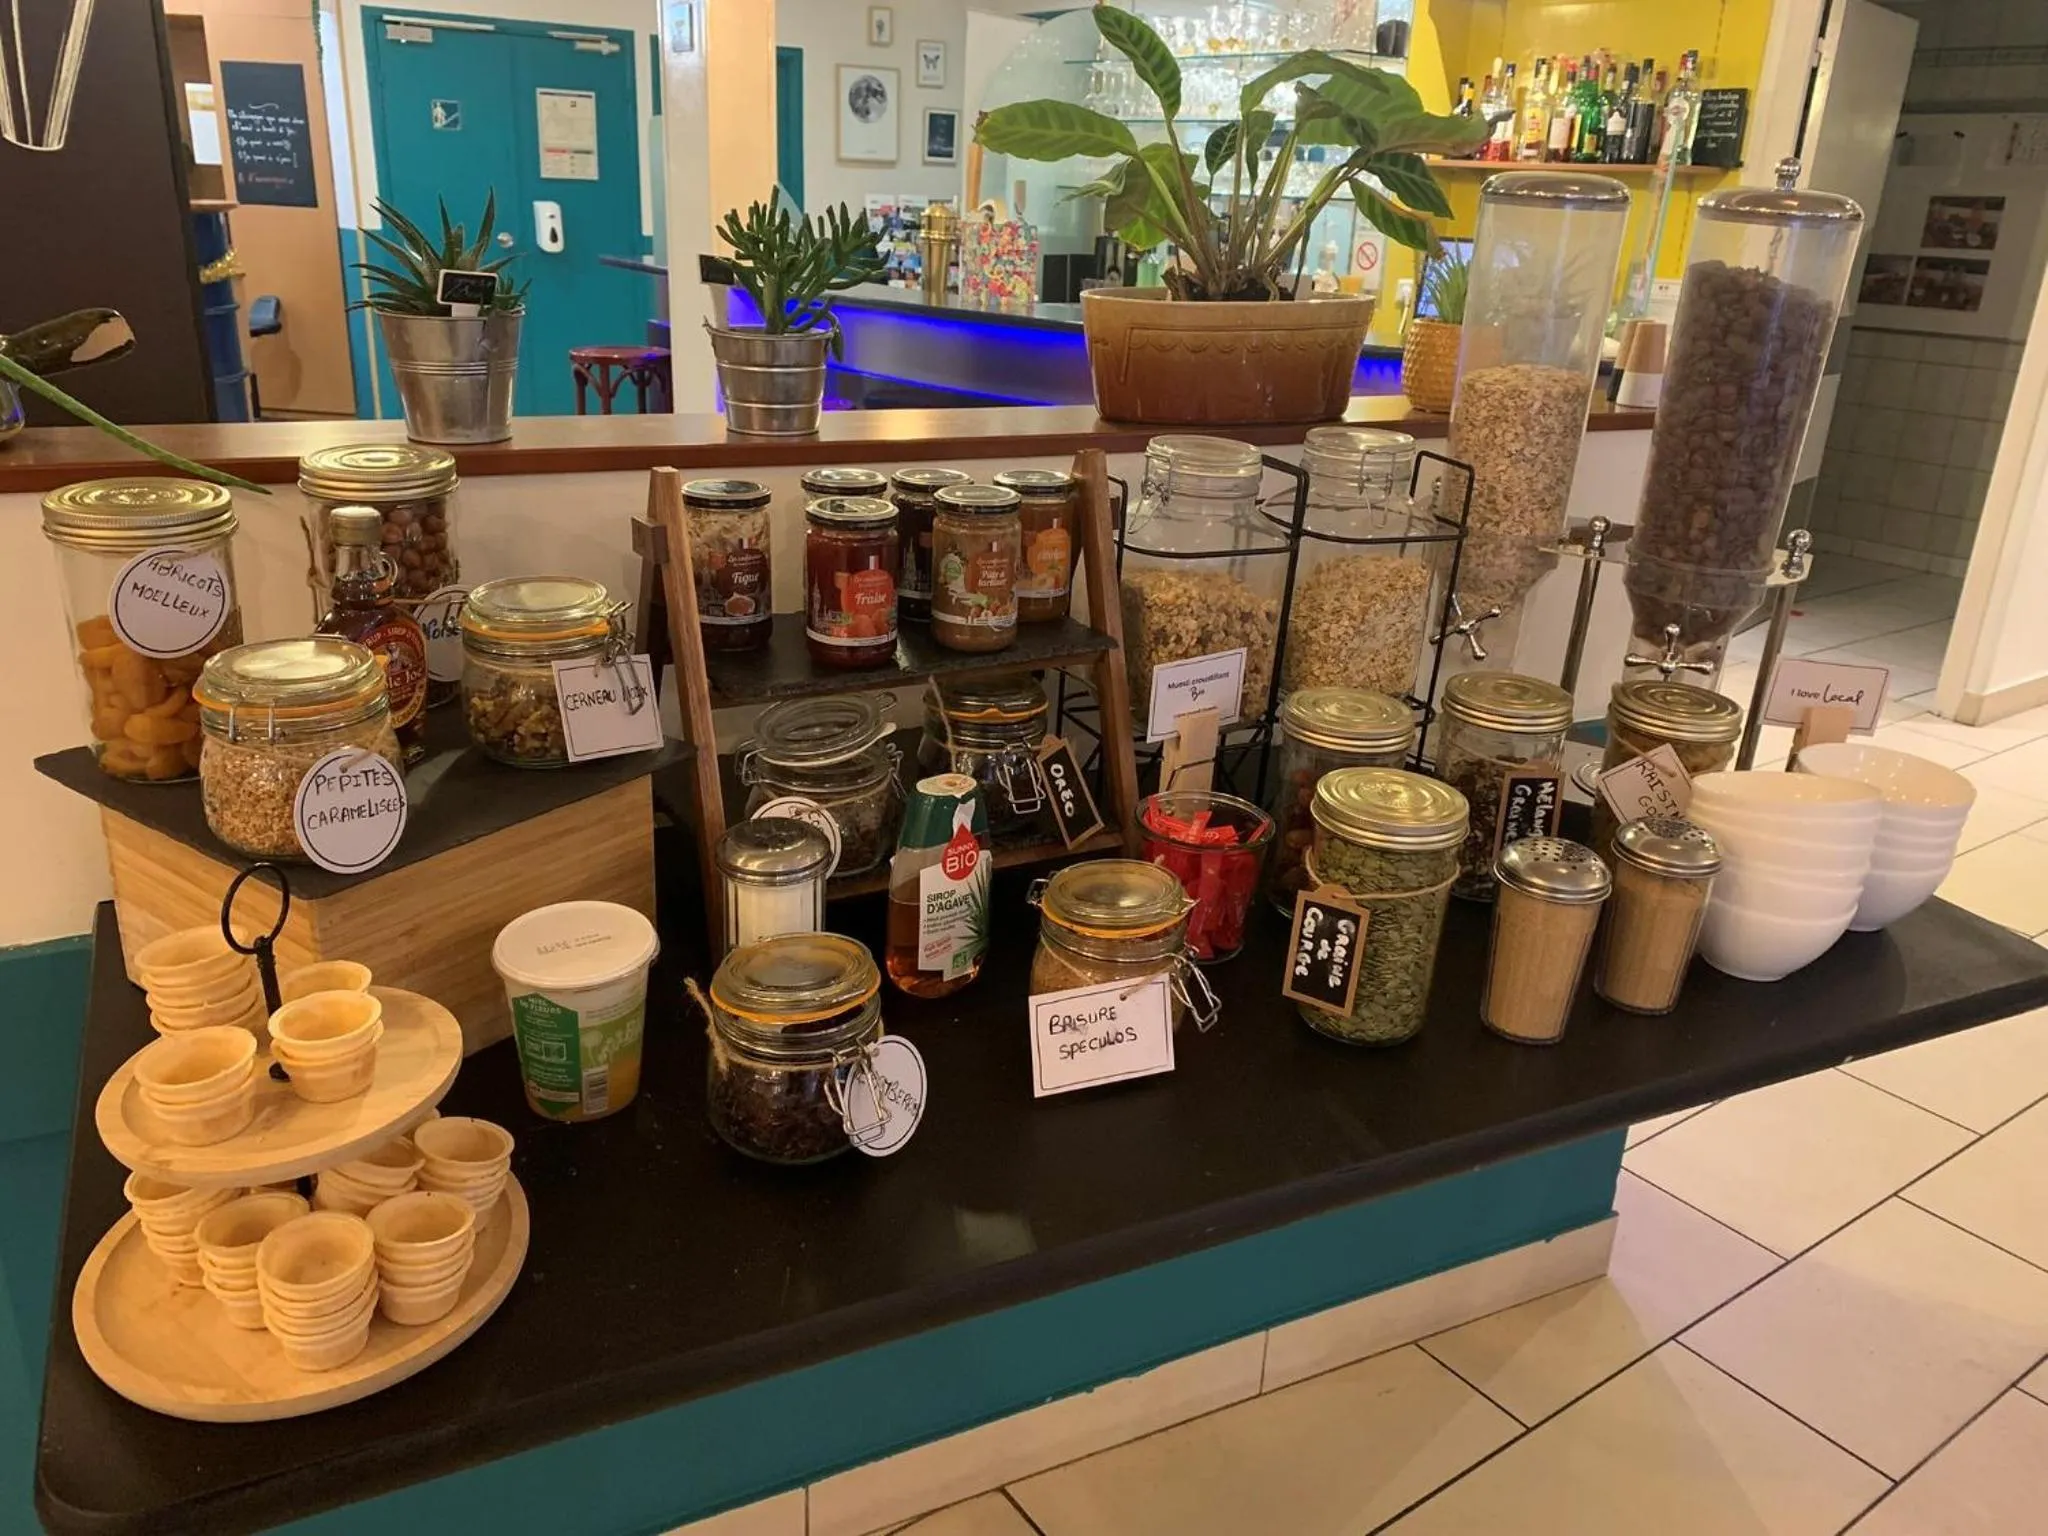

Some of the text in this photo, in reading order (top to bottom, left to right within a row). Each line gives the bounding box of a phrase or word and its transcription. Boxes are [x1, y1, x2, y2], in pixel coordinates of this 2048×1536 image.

[131, 581, 210, 618] MOELLEUX
[565, 689, 617, 711] CERNEAU
[1797, 688, 1821, 700] love
[947, 842, 975, 855] SUNNY
[945, 850, 978, 874] BIO
[926, 889, 957, 903] SIROP
[926, 895, 971, 915] D'AGAVE
[1317, 939, 1332, 961] de
[1049, 1005, 1118, 1036] BRISURE
[1058, 1027, 1138, 1061] SPECULOS
